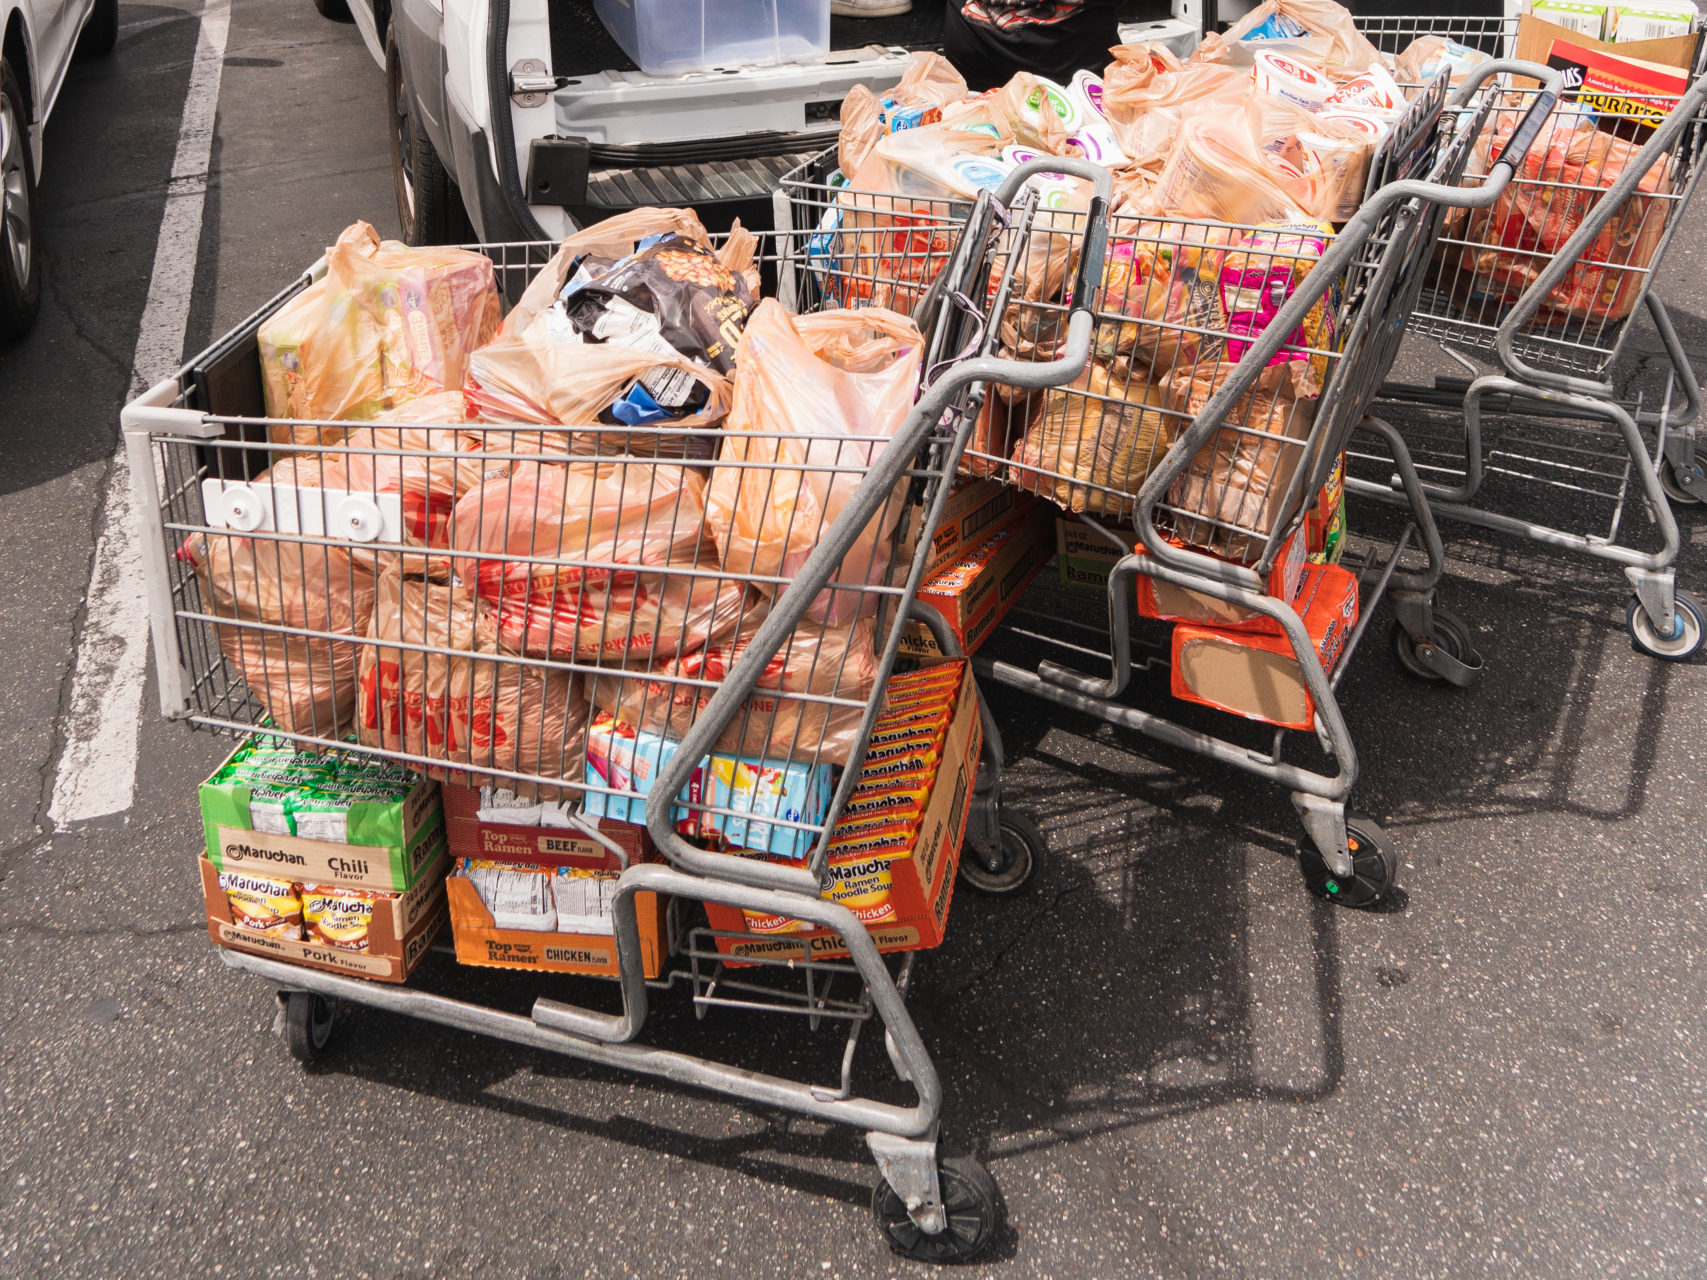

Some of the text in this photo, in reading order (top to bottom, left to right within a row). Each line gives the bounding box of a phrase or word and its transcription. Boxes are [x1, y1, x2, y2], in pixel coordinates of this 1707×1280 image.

[1587, 77, 1613, 91] America's
[482, 829, 508, 843] Top
[484, 841, 533, 855] Ramen
[546, 839, 578, 852] BEEF
[240, 844, 369, 874] Maruchan Chili
[334, 872, 364, 881] Flavor
[844, 876, 880, 890] Ramen
[227, 873, 290, 897] Maruchan
[832, 886, 868, 901] Noodle
[243, 915, 266, 930] Pork
[485, 939, 513, 953] Top
[879, 934, 909, 945] Flavor
[231, 930, 368, 971] Maruchan Pork Flavor
[488, 950, 539, 964] Ramen
[546, 948, 592, 963] CHICKEN
